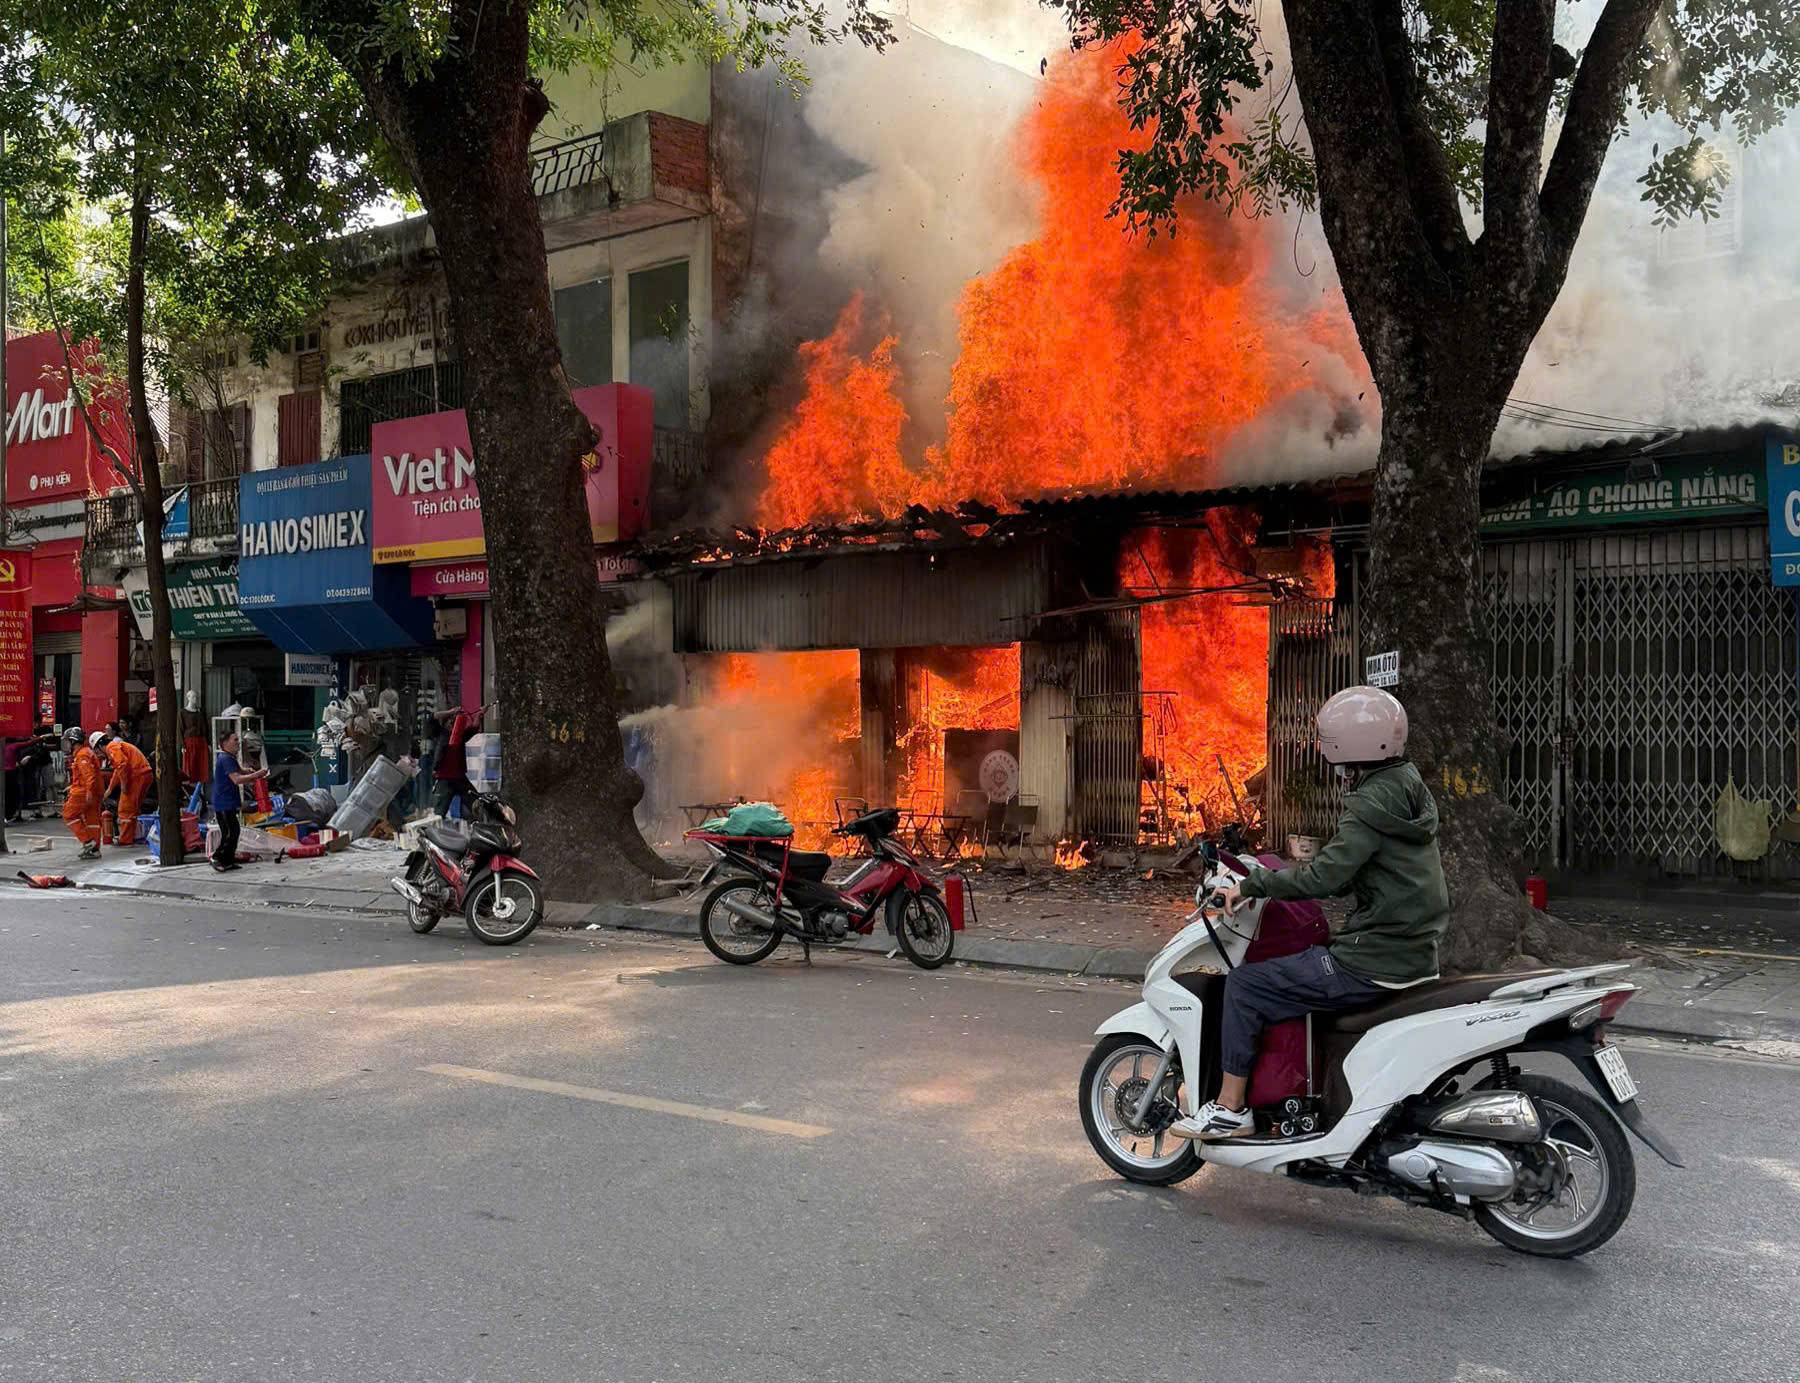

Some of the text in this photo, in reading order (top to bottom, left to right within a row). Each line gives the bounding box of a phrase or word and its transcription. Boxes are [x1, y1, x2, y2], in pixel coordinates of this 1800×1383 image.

[6, 388, 76, 446] Mart
[383, 447, 446, 496] Viet
[412, 493, 481, 518] Tiện ích cho
[242, 509, 365, 557] HANOSIMEX
[210, 559, 240, 577] THUỐ
[435, 568, 455, 584] Cửa
[457, 567, 484, 584] Hàng
[167, 581, 240, 610] THIÊN TH
